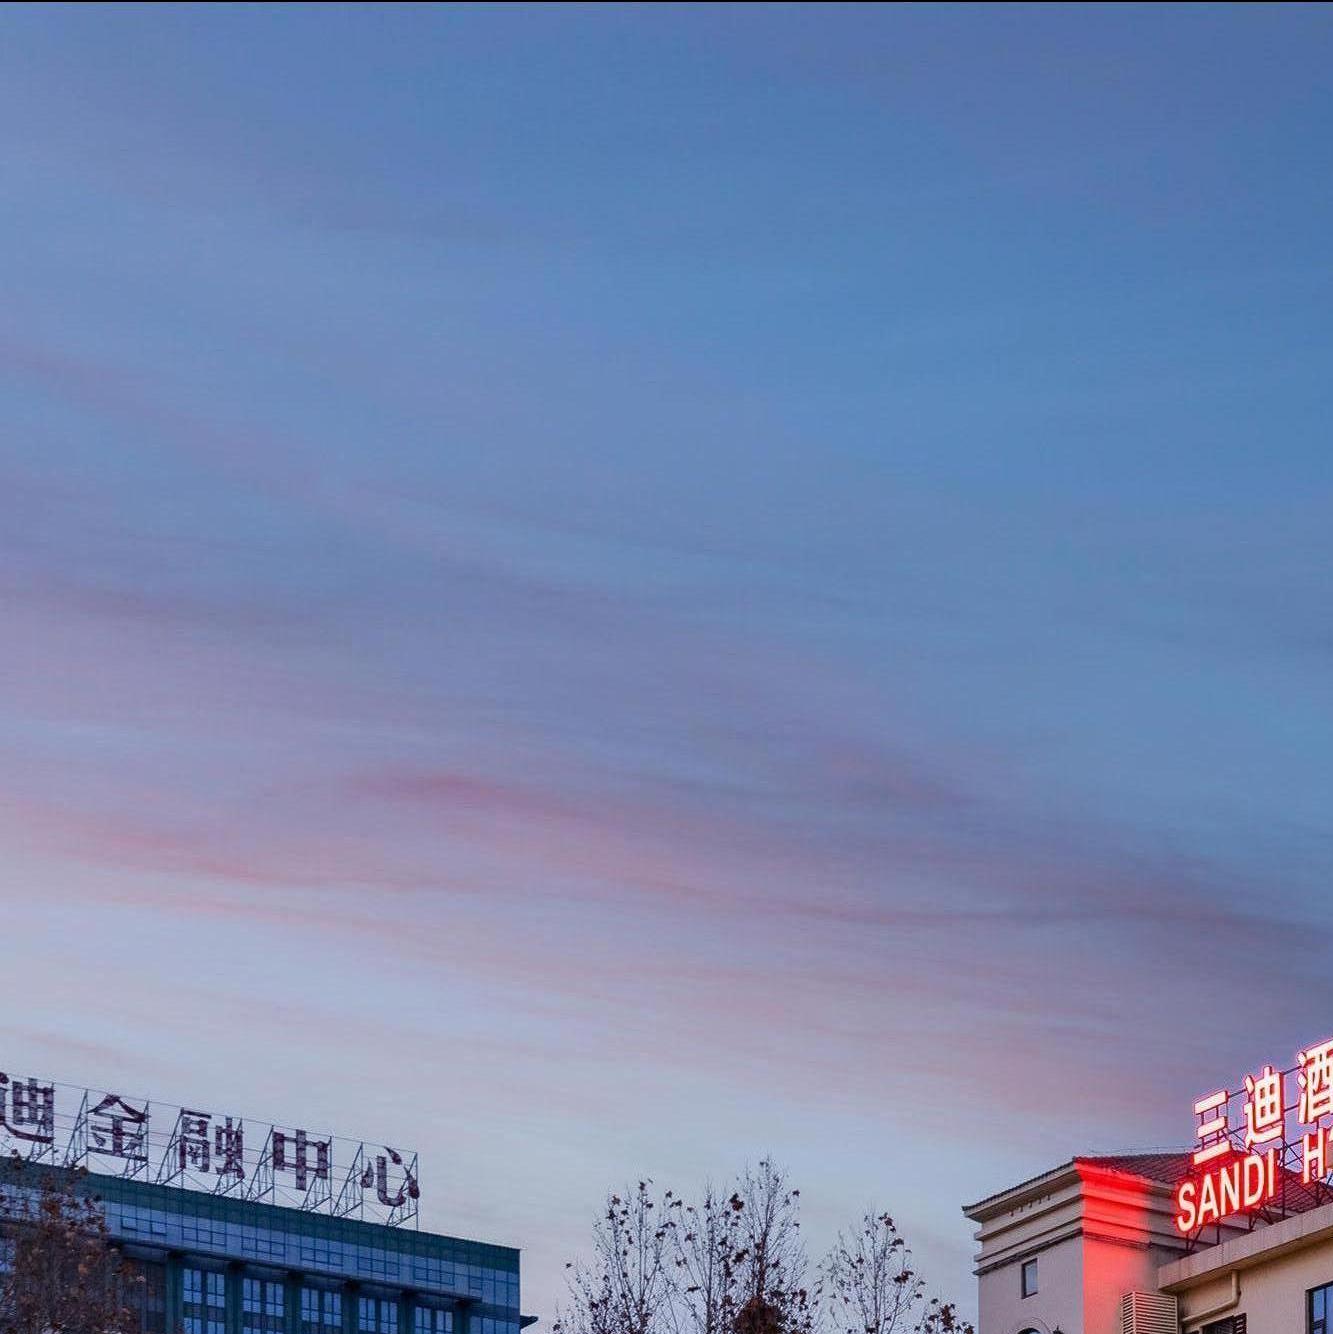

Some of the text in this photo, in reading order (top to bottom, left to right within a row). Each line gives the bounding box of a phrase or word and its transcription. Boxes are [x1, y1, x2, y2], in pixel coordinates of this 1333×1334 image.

[0, 1071, 419, 1207] 迪金融中心
[1177, 1149, 1276, 1232] SANDI
